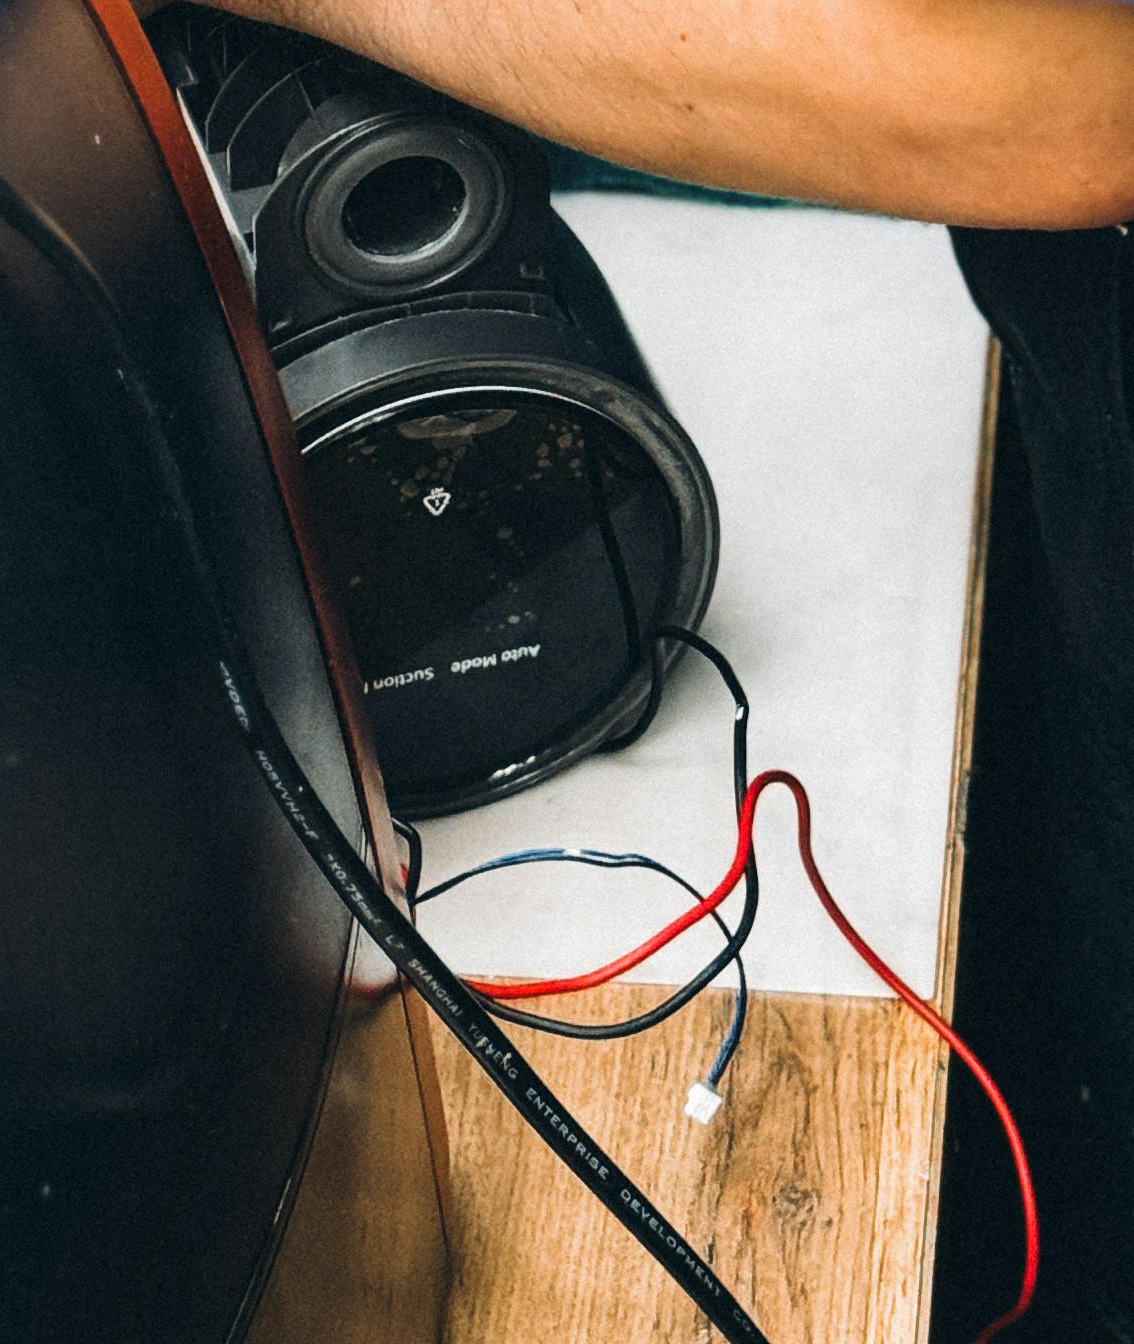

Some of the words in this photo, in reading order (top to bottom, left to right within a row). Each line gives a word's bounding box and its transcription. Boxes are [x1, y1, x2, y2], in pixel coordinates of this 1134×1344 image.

[501, 643, 541, 662] Auto
[451, 653, 496, 674] Mode
[373, 667, 434, 689] Suction
[410, 958, 464, 1016] SHANGHAI
[526, 1087, 608, 1180] ENTERPRISE
